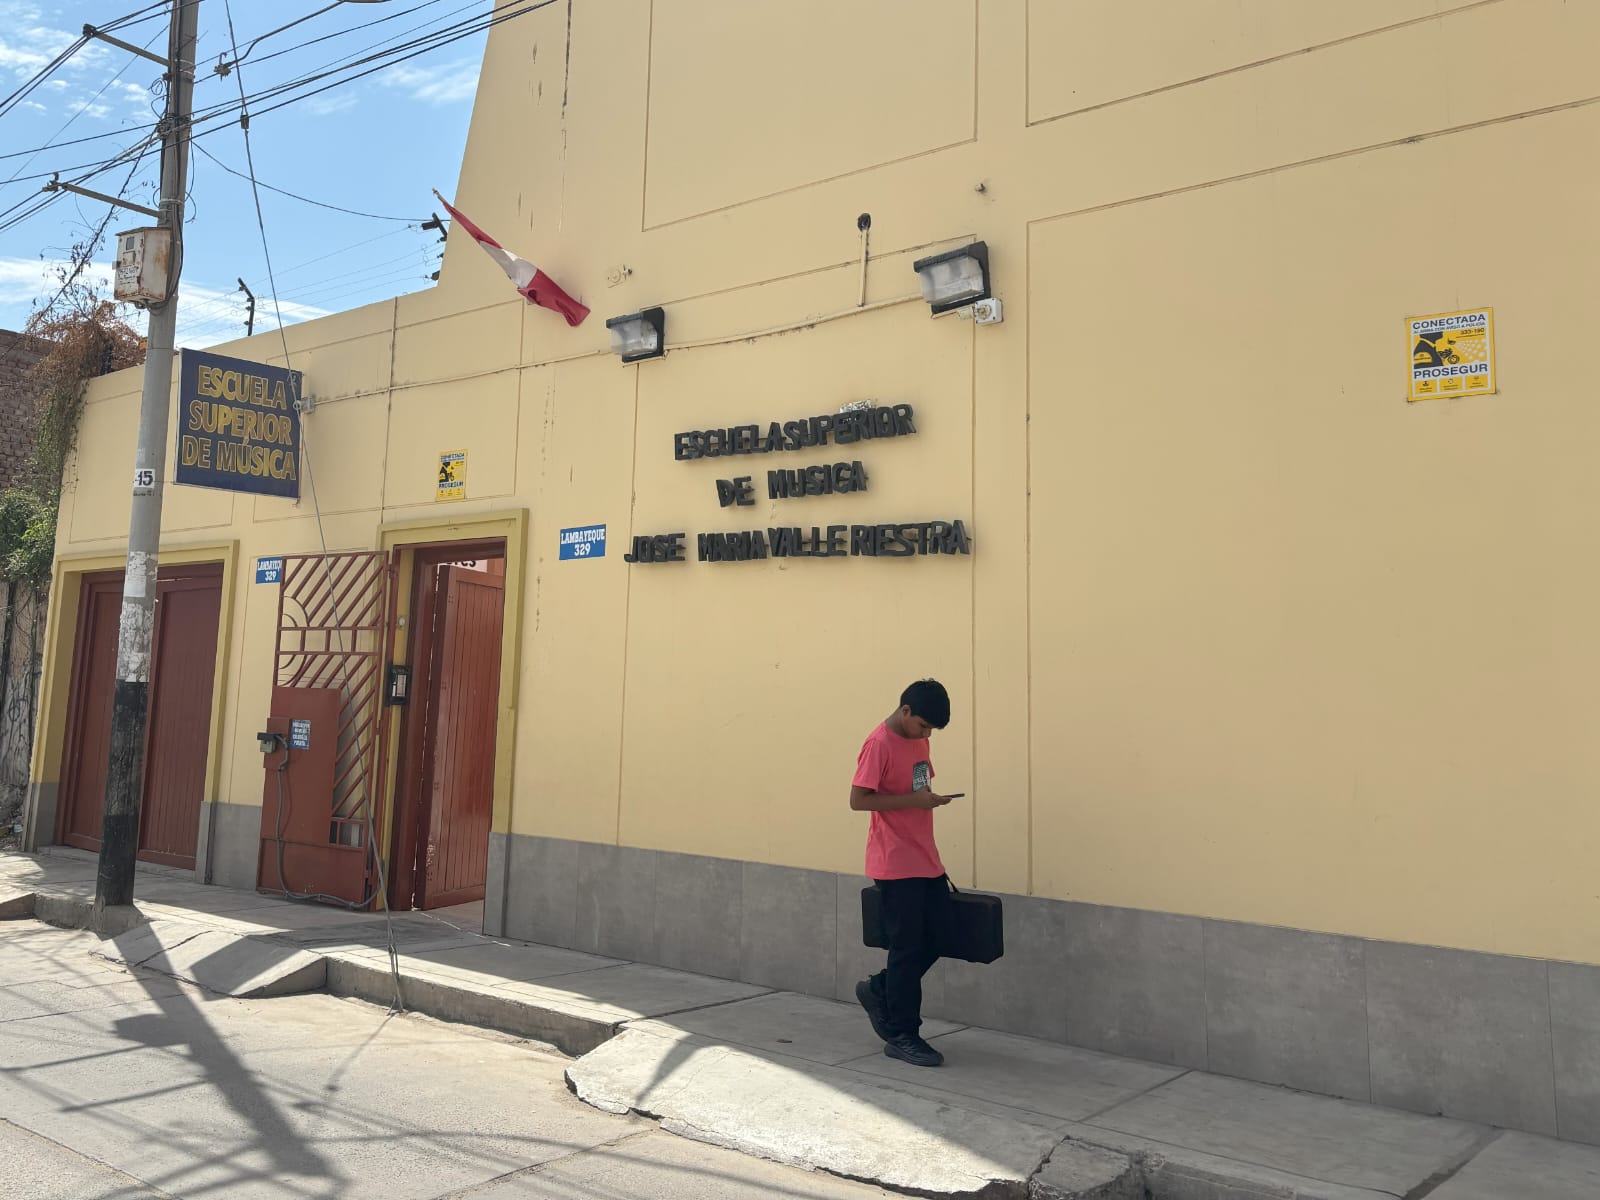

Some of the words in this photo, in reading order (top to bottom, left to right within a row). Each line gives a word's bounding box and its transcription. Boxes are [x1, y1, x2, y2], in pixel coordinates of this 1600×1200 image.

[1413, 314, 1485, 329] CONECTADA
[198, 365, 287, 410] ESCUELA
[1414, 363, 1488, 379] PROSEGUR
[189, 400, 293, 445] SUPERIOR
[674, 421, 784, 461] ESCUELA
[783, 403, 917, 451] SUPERIOR
[182, 435, 211, 469] DE
[216, 437, 296, 480] MÚSICA
[716, 476, 755, 508] DE
[767, 461, 868, 500] MUSICA
[561, 528, 606, 545] LAMBAYEQUE
[574, 542, 591, 557] 329
[624, 533, 687, 563] JOSE
[697, 530, 767, 562] MARIA
[767, 525, 848, 557] VALLE
[850, 519, 971, 557] RIESTRA
[264, 570, 277, 582] 329
